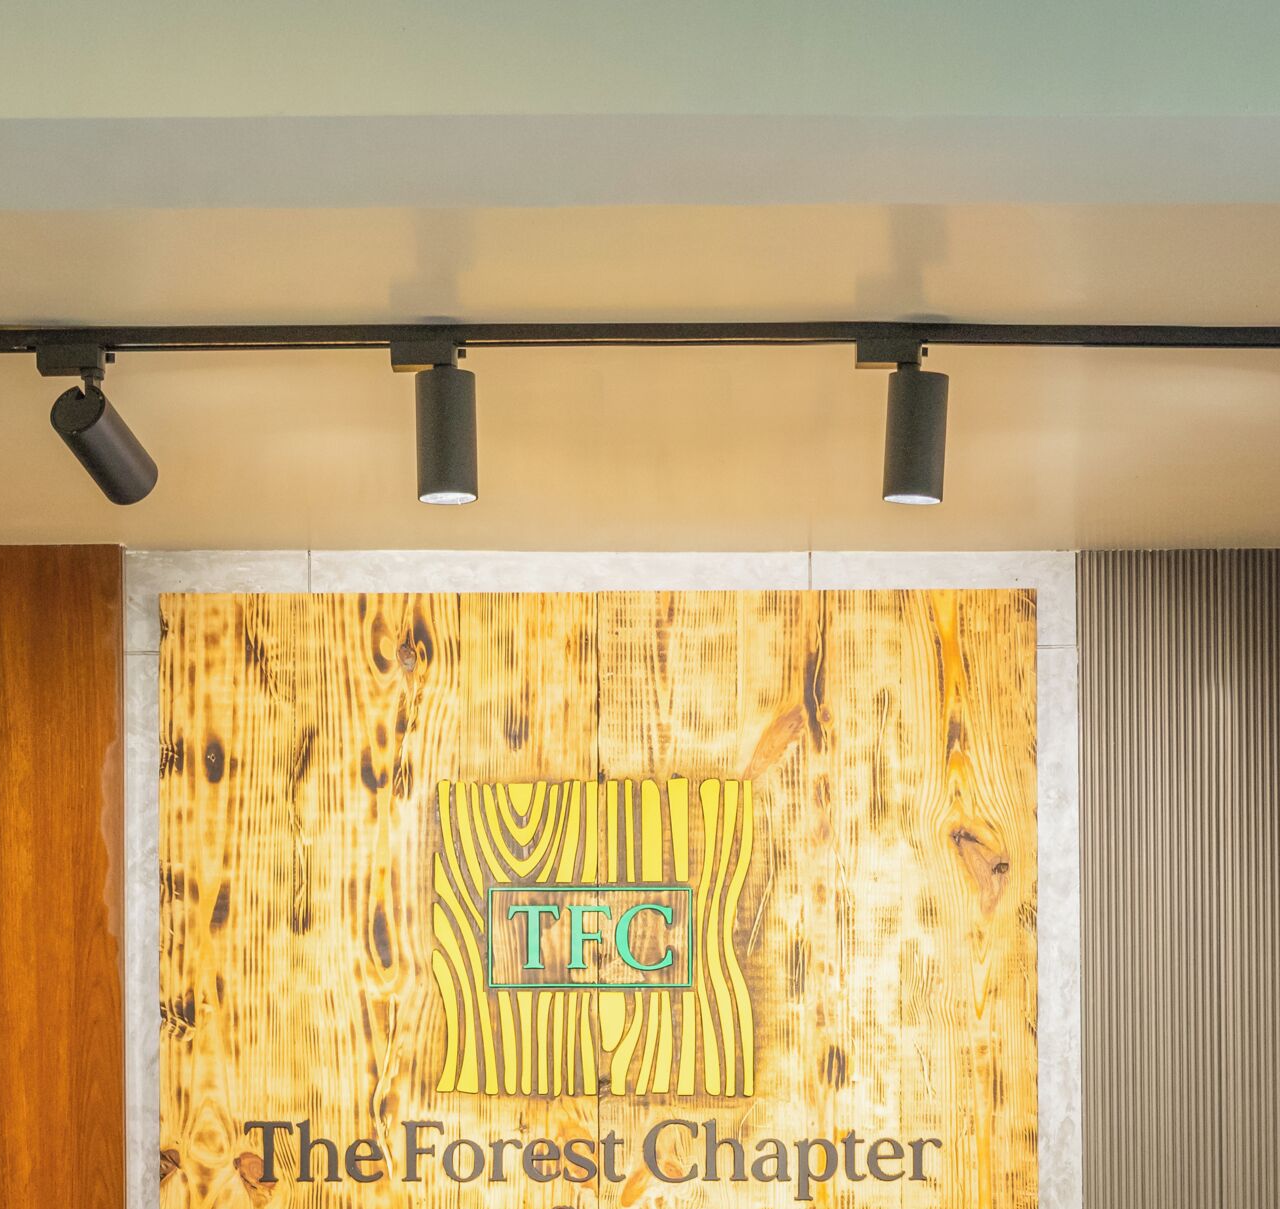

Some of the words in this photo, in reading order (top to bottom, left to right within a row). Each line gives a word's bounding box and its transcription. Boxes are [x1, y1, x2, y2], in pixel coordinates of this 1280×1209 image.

[508, 903, 674, 971] TFC
[244, 1119, 384, 1184] The
[401, 1120, 626, 1184] Forest
[643, 1118, 943, 1202] Chapter
